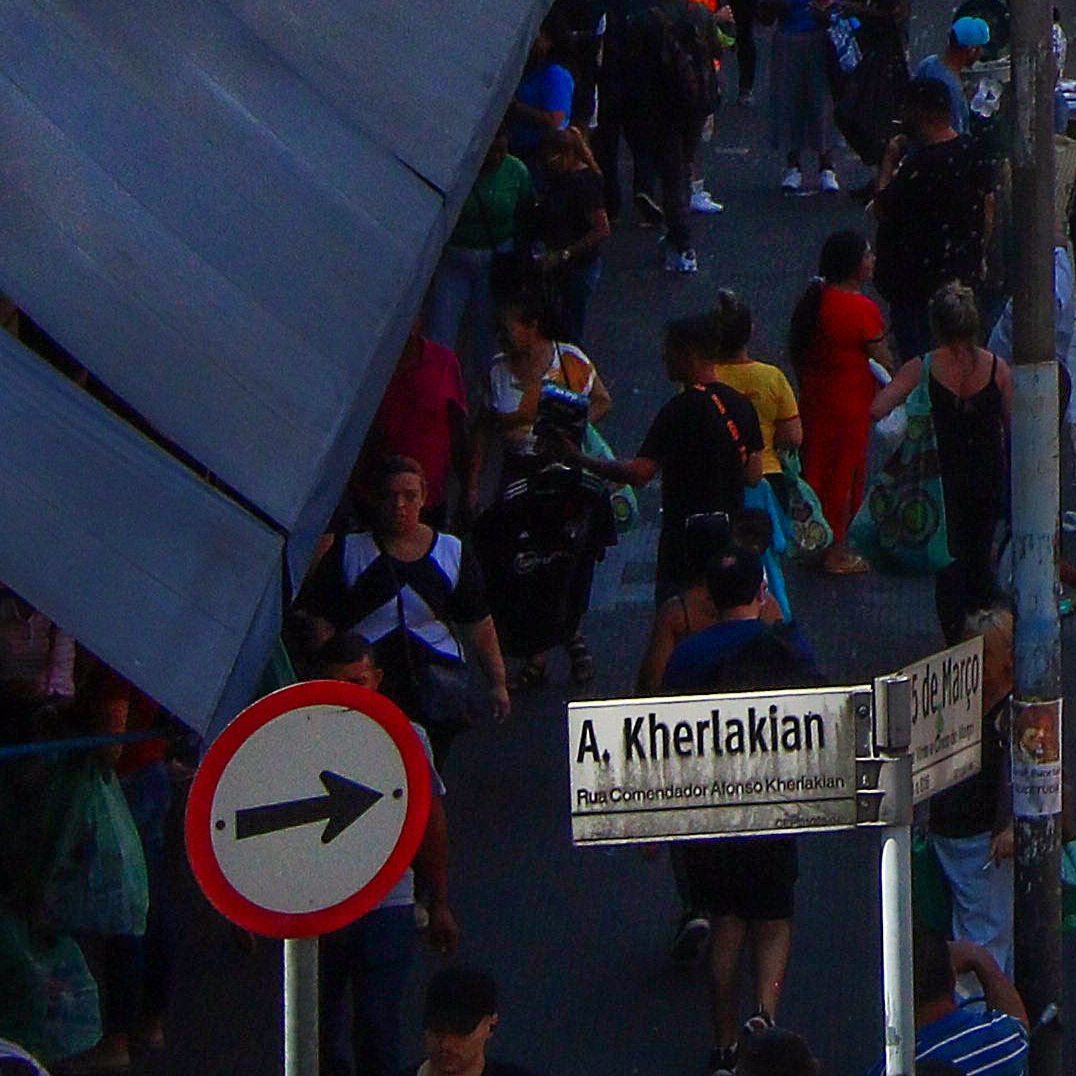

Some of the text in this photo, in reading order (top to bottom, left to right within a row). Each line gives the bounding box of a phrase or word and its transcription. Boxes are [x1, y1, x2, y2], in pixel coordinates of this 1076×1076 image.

[922, 663, 938, 719] de
[942, 652, 979, 711] Março
[623, 703, 825, 761] Kherlakian
[576, 788, 608, 806] Rua
[610, 783, 708, 802] Comendador
